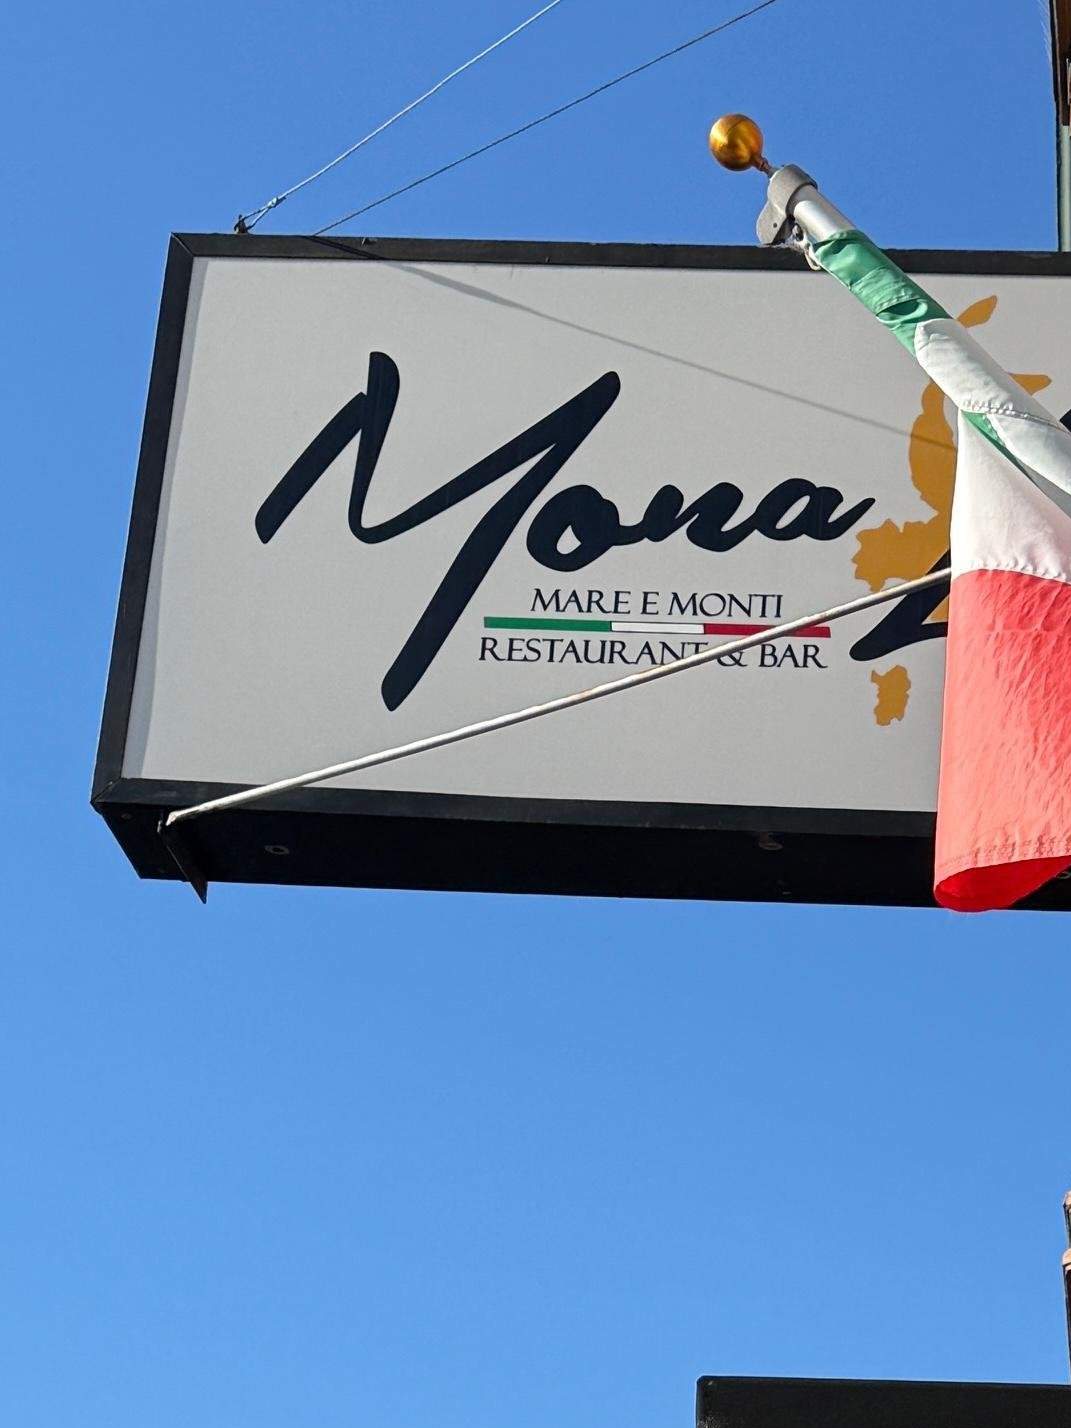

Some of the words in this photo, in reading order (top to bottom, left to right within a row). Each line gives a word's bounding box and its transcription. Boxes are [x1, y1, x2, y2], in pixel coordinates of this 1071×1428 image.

[255, 351, 876, 711] Mona
[531, 588, 632, 614] MARE
[641, 591, 659, 615] E
[669, 592, 783, 618] MONTI
[479, 636, 708, 665] RESTAURANT
[759, 643, 828, 669] BAR
